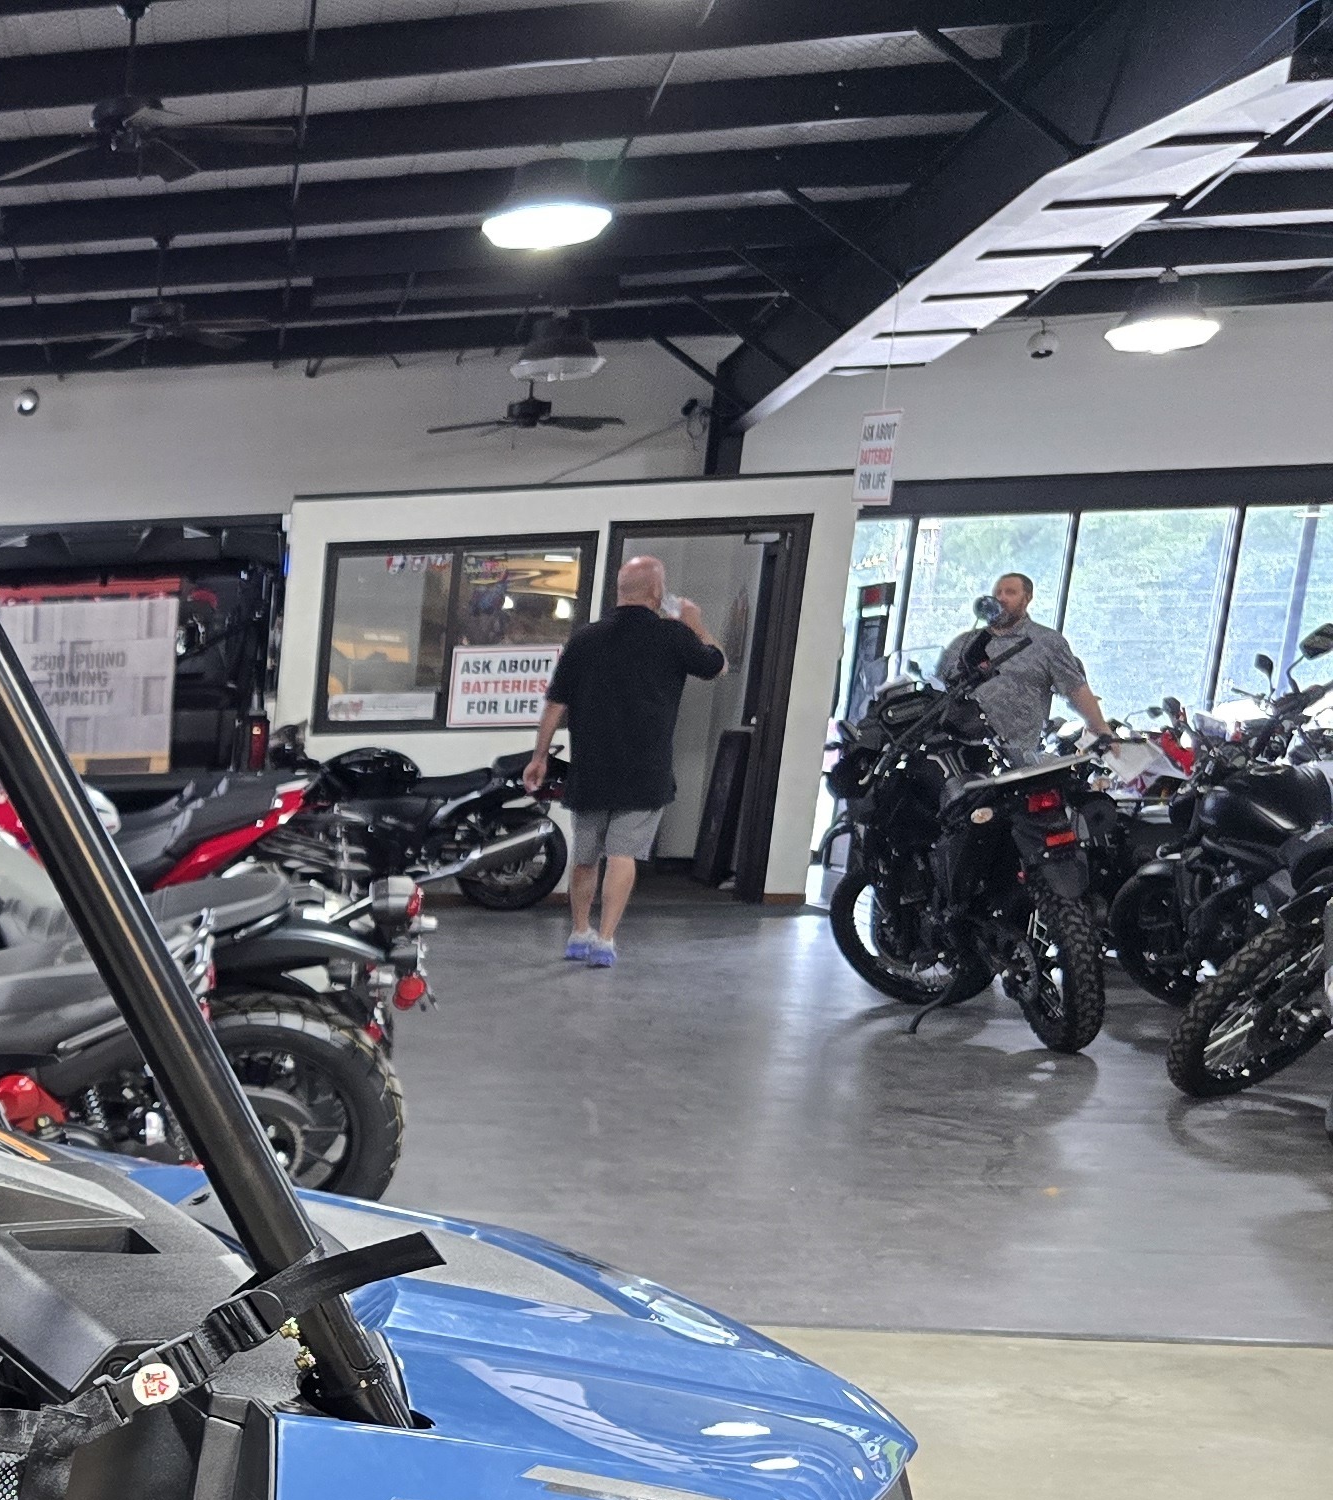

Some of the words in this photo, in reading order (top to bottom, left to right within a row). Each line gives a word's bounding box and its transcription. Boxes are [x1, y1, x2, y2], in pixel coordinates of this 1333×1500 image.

[460, 659, 492, 675] ASK
[496, 658, 552, 674] ABOUT
[460, 679, 549, 695] BATTERIES
[42, 689, 115, 706] CAPACITY
[466, 700, 498, 715] FOR
[504, 699, 539, 714] LIFE
